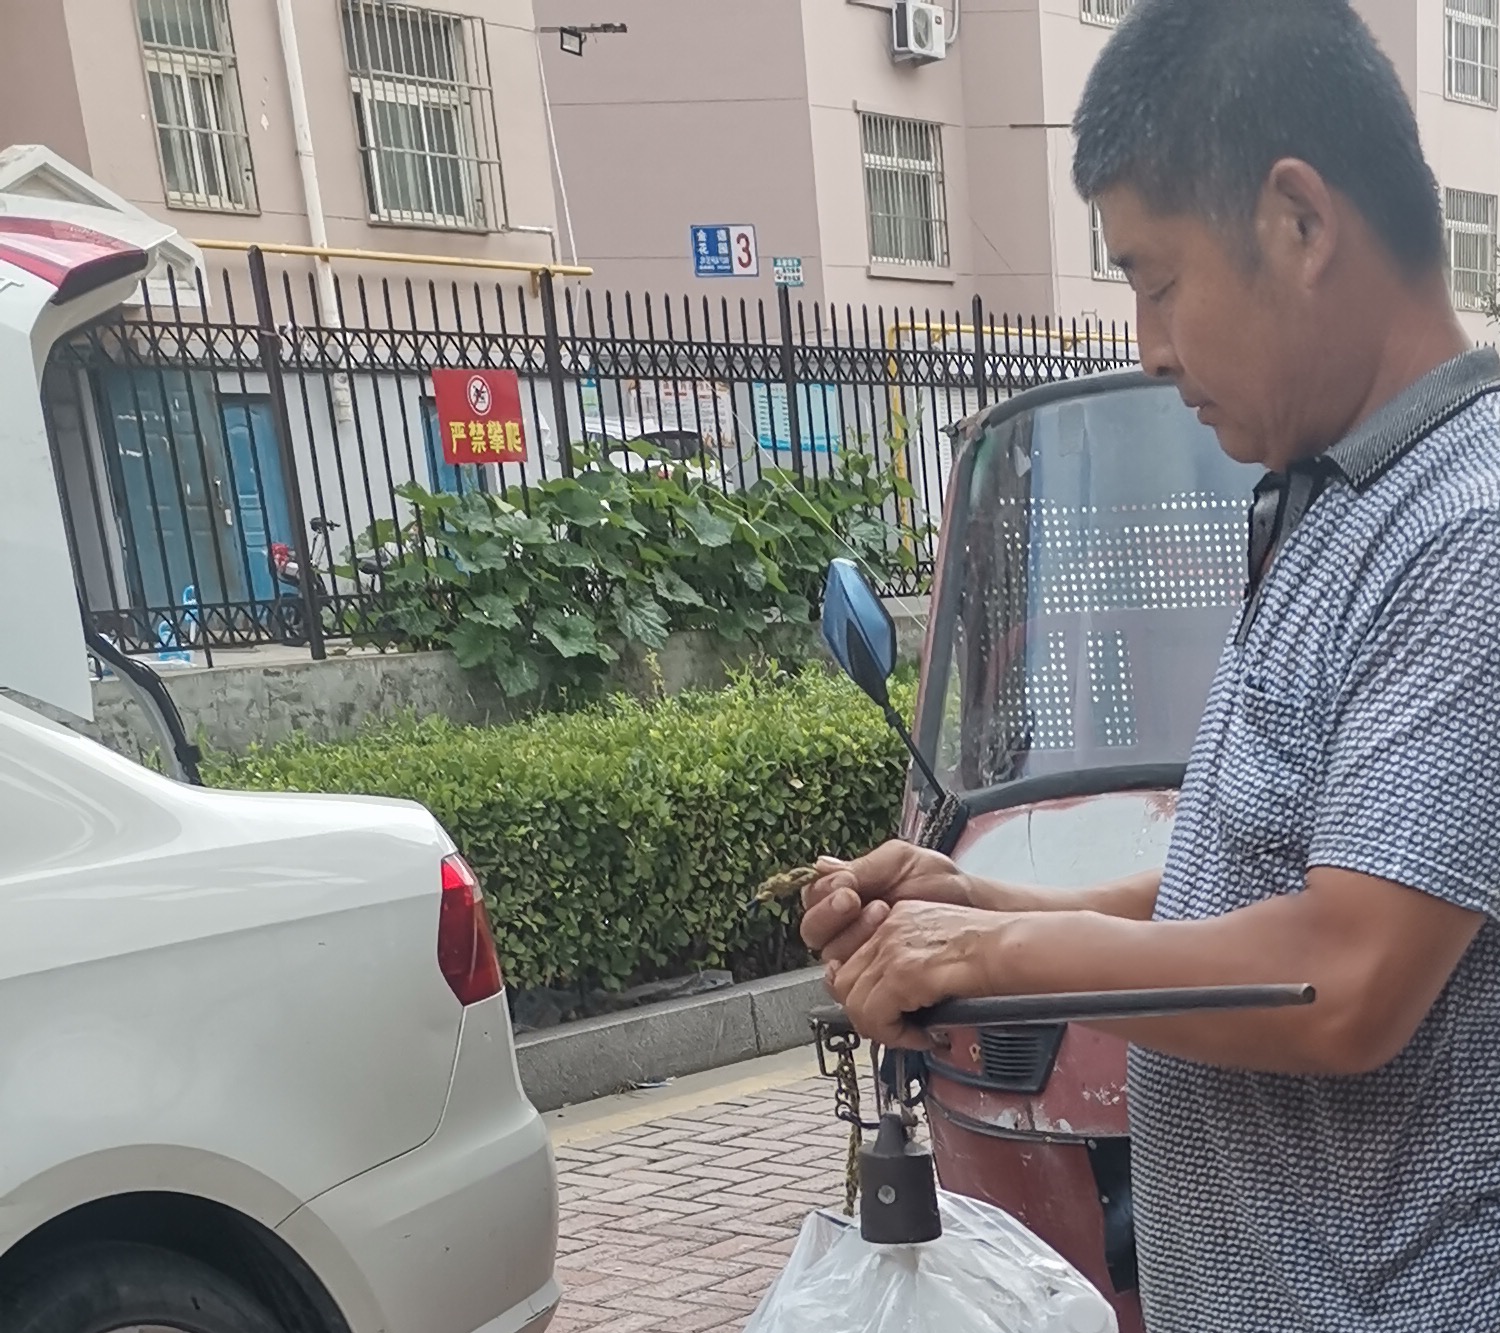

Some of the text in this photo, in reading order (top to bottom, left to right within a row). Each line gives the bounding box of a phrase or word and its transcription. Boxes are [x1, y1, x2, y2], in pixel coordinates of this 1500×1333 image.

[736, 232, 753, 269] 3
[449, 420, 523, 455] 严禁攀爬
